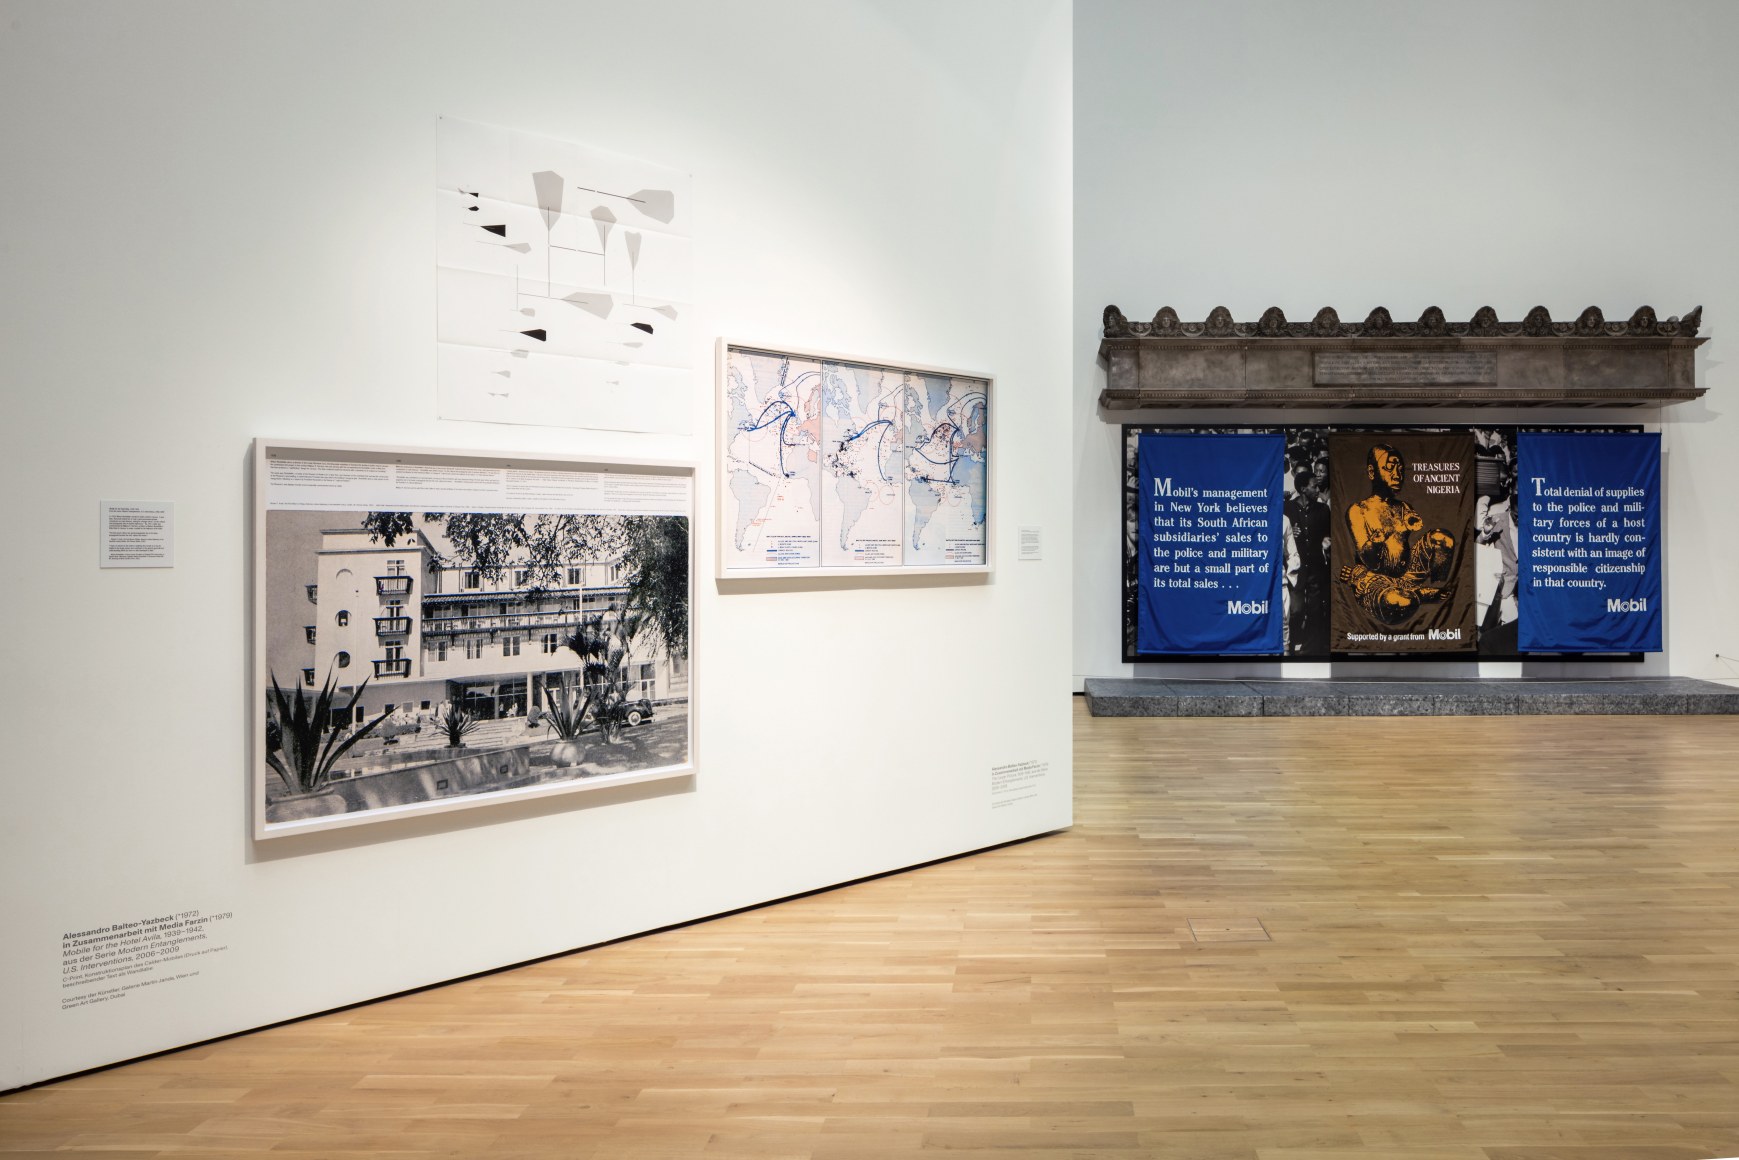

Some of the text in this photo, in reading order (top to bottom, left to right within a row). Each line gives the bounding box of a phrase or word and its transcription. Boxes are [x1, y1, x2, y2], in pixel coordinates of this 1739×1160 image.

[1412, 462, 1460, 472] TREASURES
[1425, 474, 1460, 483] ANCIENT
[1427, 485, 1460, 494] NIGERIA
[1532, 477, 1644, 498] Total denial of supplies
[1203, 489, 1268, 500] management
[1154, 502, 1268, 512] in New York believes
[1533, 502, 1644, 514] to the police and mili-
[1154, 517, 1268, 528] that its South African
[1533, 518, 1554, 529] tary
[1559, 518, 1590, 527] forces
[1596, 518, 1606, 528] of
[1624, 518, 1645, 528] host
[1226, 533, 1252, 542] sales
[1258, 534, 1268, 542] to
[1533, 533, 1646, 544] country is hardly con-
[1154, 547, 1268, 560] the police and military
[1532, 548, 1646, 560] sistent with an image of
[1154, 564, 1170, 572] are
[1174, 563, 1190, 573] but
[1205, 564, 1230, 573] small
[1235, 564, 1254, 575] part
[1259, 564, 1269, 573] of
[1532, 563, 1646, 574] responsible citizenship
[1154, 578, 1165, 588] its
[1169, 578, 1190, 588] total
[1194, 578, 1218, 588] sales
[1533, 577, 1606, 590] in that country.
[1228, 600, 1268, 614] Mobil
[1607, 598, 1647, 612] Mobil
[1347, 632, 1379, 641] Supported
[1379, 632, 1387, 642] by
[1393, 632, 1409, 642] grant
[1428, 628, 1461, 640] Mobil
[63, 928, 110, 940] Alessandro
[112, 915, 174, 931] Balteo-Yazbeck
[72, 929, 142, 947] Zusammenarbeit
[159, 921, 183, 931] Media
[185, 917, 208, 926] Farzin
[63, 947, 90, 957] Mobile
[120, 937, 141, 946] Hotel
[95, 951, 116, 959] Serie
[118, 945, 148, 955] Modern
